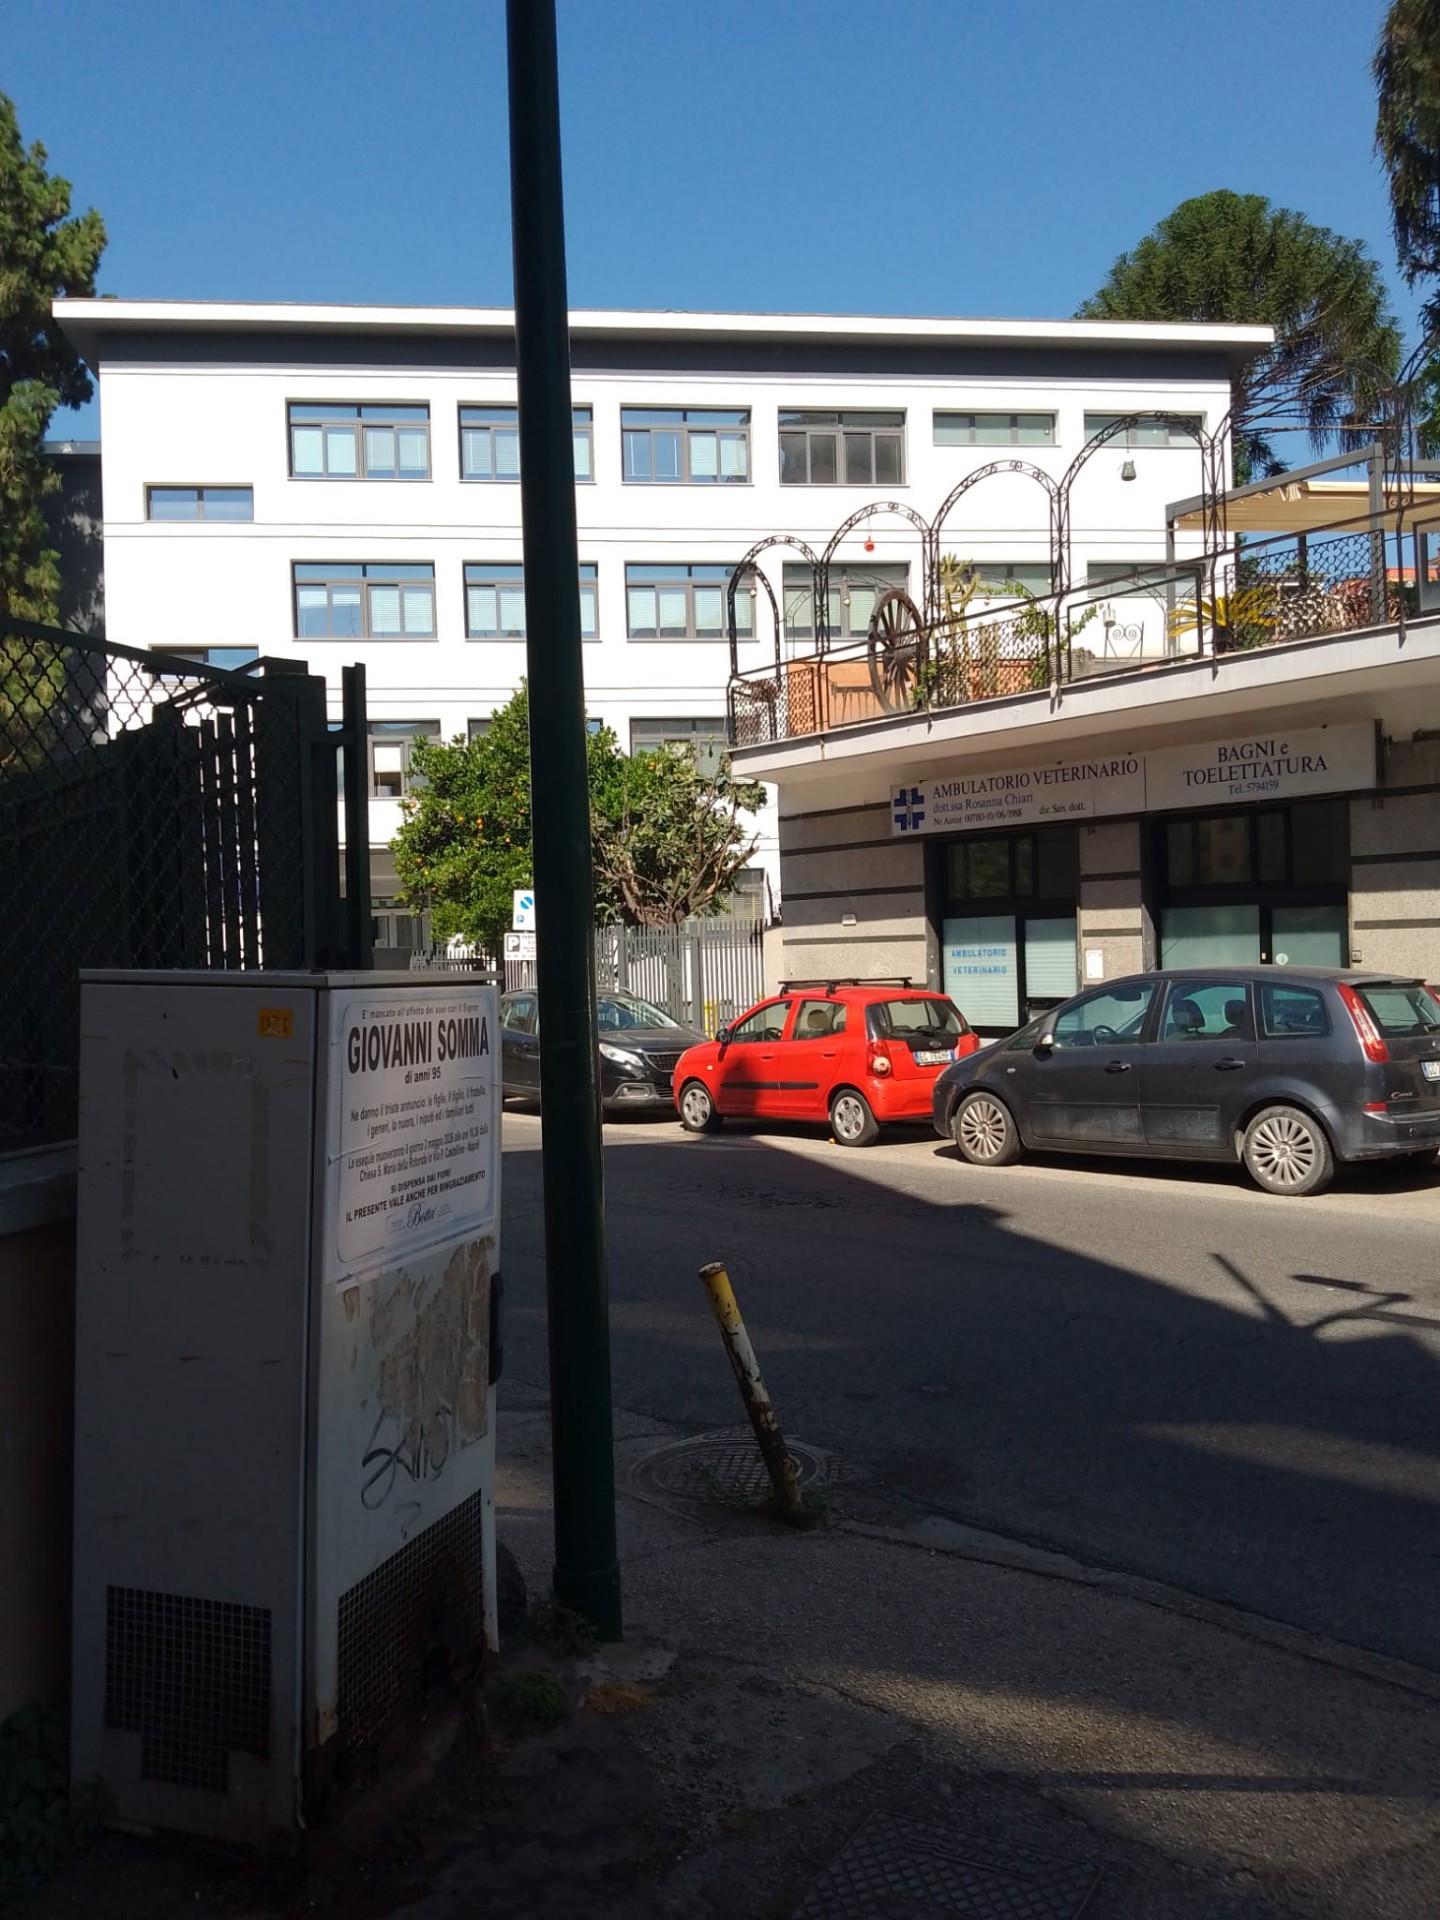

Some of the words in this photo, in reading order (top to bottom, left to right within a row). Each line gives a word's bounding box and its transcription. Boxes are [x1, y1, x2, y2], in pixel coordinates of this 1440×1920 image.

[1217, 740, 1275, 763] BAGNI
[1280, 743, 1288, 754] e
[932, 773, 1031, 799] AMBULATORIO
[1033, 758, 1139, 786] VETERINARIO
[1183, 754, 1328, 786] TOELETTATURA
[1229, 783, 1243, 795] Tel.
[1246, 779, 1279, 793] 5794159
[965, 797, 1003, 811] Rosanna
[1005, 792, 1033, 807] Chiari
[951, 948, 1007, 958] AMBULATORIO
[952, 966, 1008, 975] VETERINARIO
[347, 1021, 432, 1074] GIOVANNI
[437, 1016, 489, 1062] SOMMA
[405, 1070, 413, 1084] di
[414, 1068, 430, 1083] anni
[432, 1066, 441, 1080] 95
[351, 1109, 359, 1122] Ne
[360, 1105, 378, 1121] danno
[385, 1102, 399, 1116] triste
[420, 1112, 434, 1126] nipoti
[355, 1153, 375, 1169] esequie
[409, 1141, 424, 1158] giorno
[360, 1168, 377, 1183] Chiesa
[383, 1162, 396, 1176] Maria
[391, 1182, 397, 1194] SI
[398, 1175, 426, 1192] DISPENSA
[427, 1171, 436, 1183] DAI
[437, 1168, 451, 1181] FIORI
[345, 1211, 353, 1223] IL
[353, 1200, 387, 1220] PRESENTE
[388, 1194, 405, 1209] VALE
[405, 1188, 426, 1204] ANCHE
[427, 1184, 438, 1197] PER
[439, 1169, 486, 1192] RINGRAZIAMENTO
